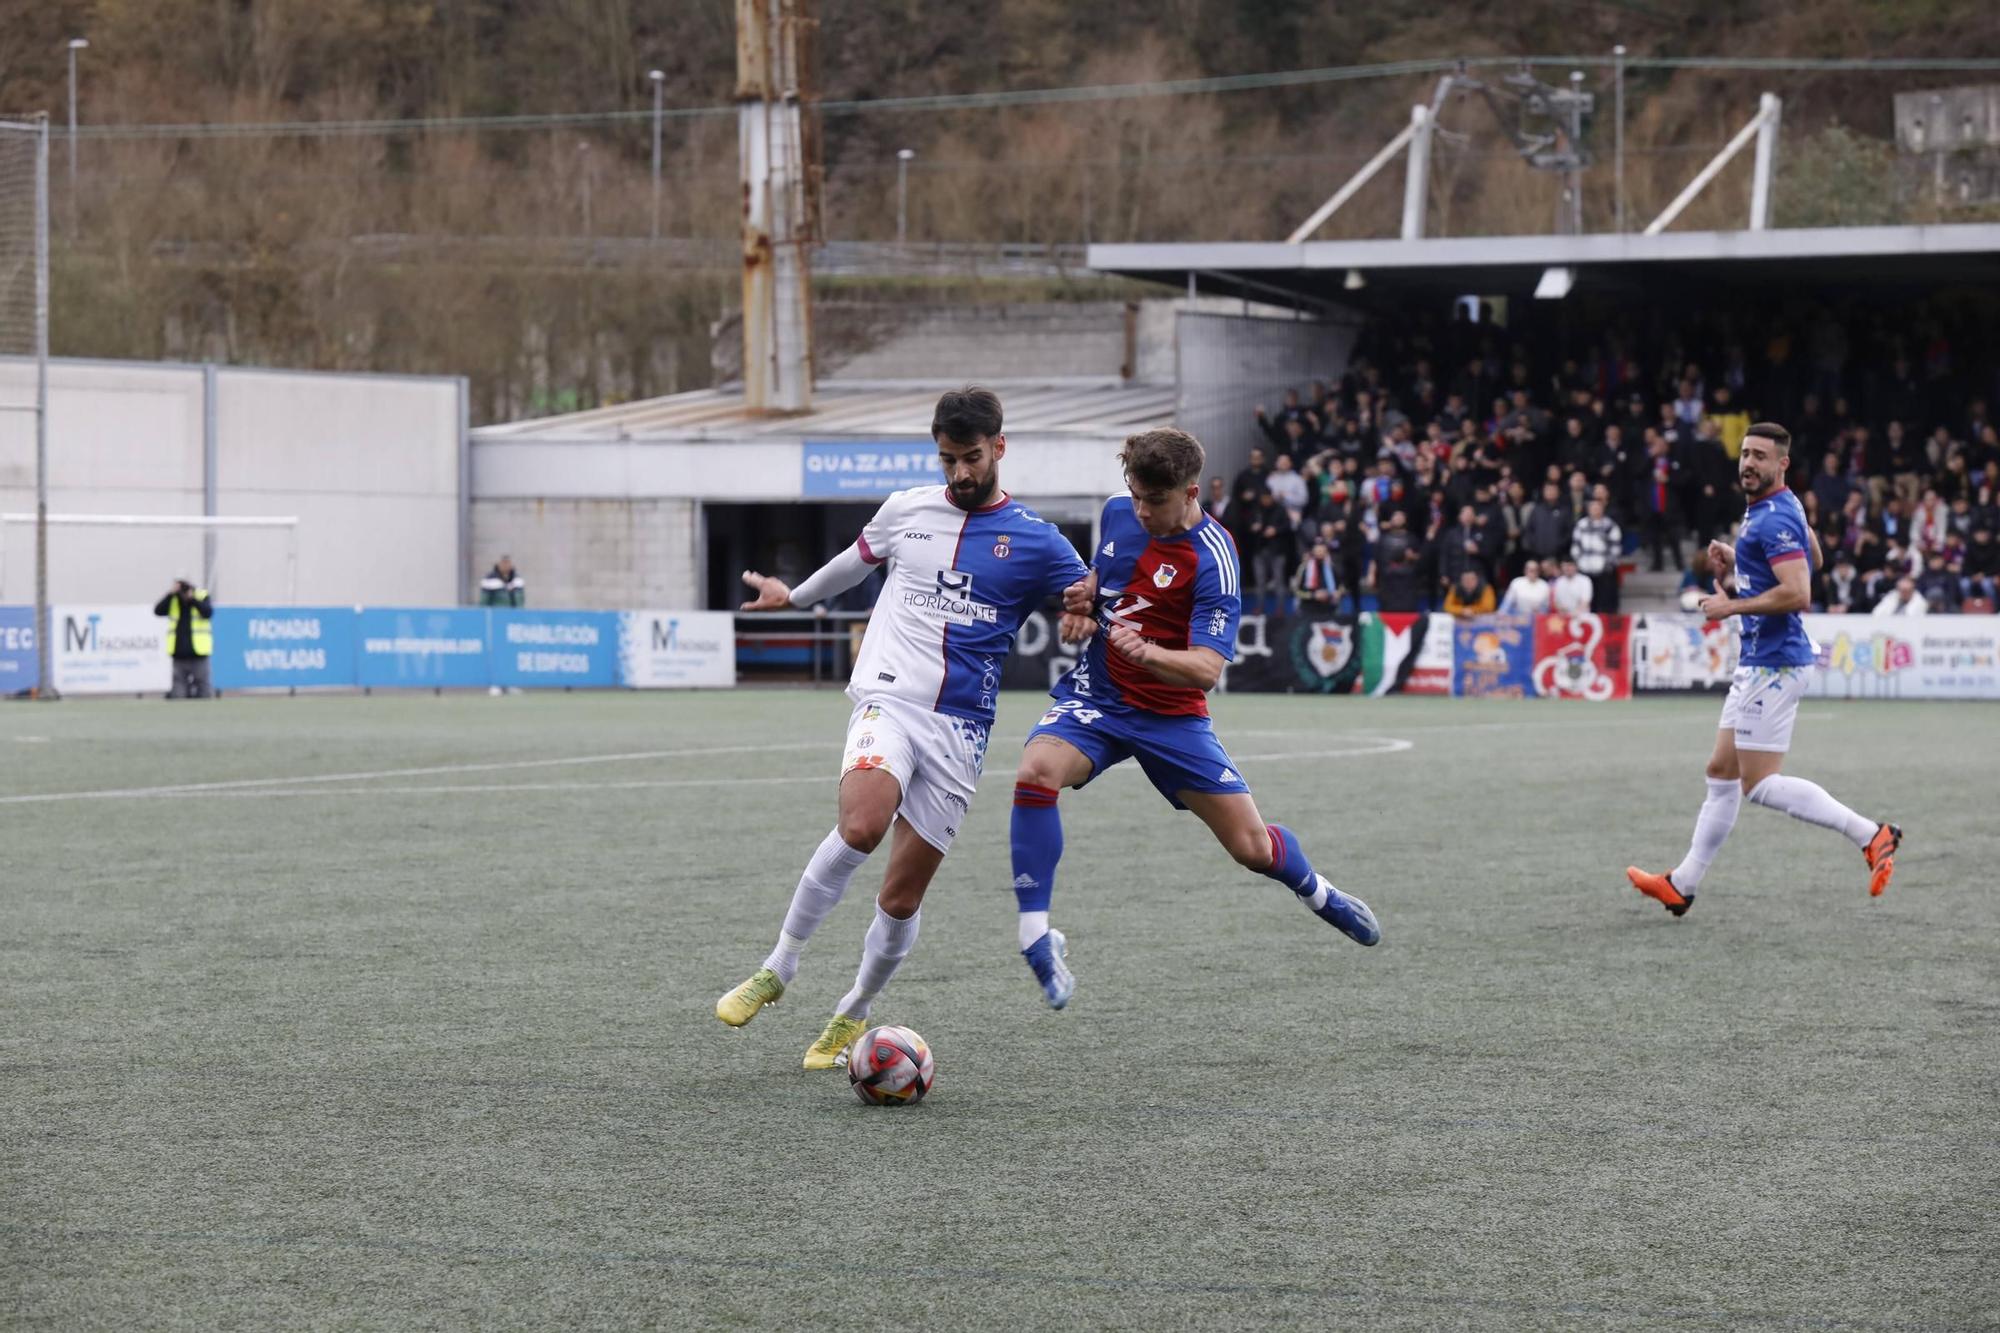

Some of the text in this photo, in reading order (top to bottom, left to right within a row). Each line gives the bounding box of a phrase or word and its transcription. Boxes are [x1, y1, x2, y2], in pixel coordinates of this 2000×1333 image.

[903, 531, 934, 541] NOONE
[903, 592, 996, 622] HORIZONTE
[923, 611, 970, 625] PATRIMONIAL
[248, 618, 321, 640] FACHADAS
[244, 648, 326, 671] VENTILADAS
[517, 652, 534, 672] DE
[1051, 700, 1104, 725] 24
